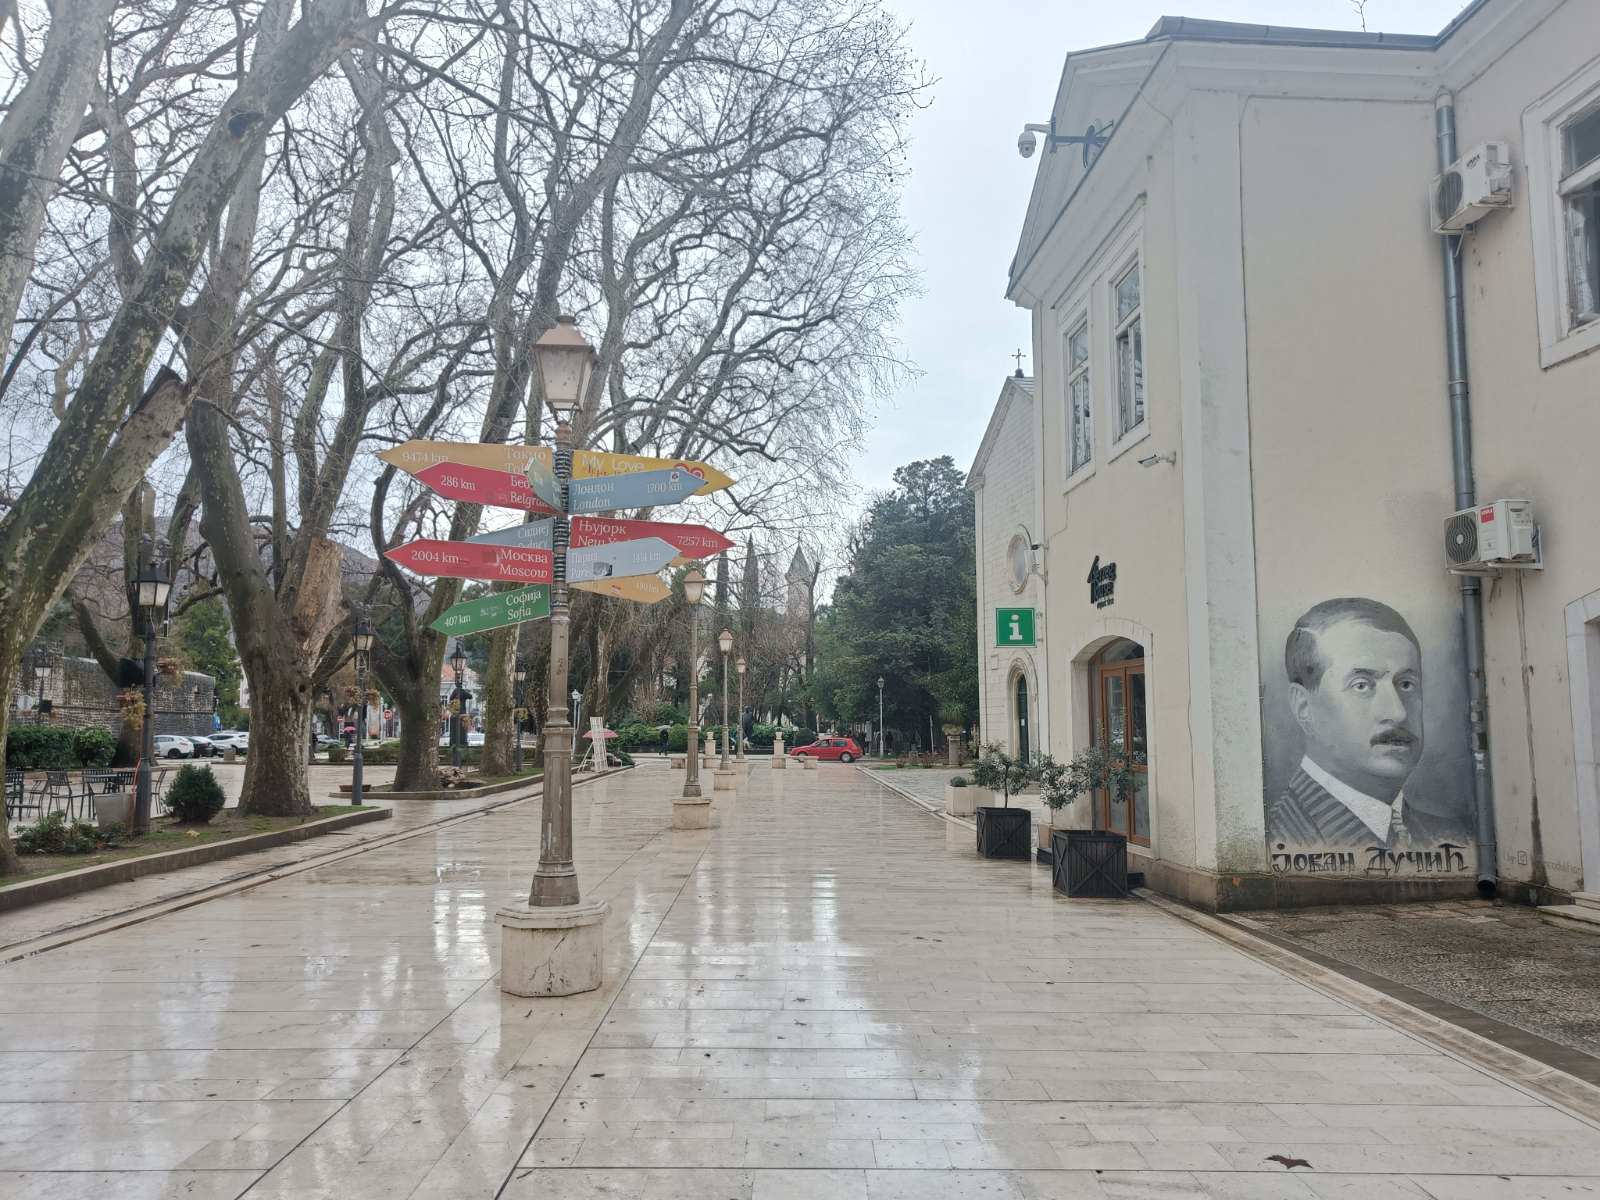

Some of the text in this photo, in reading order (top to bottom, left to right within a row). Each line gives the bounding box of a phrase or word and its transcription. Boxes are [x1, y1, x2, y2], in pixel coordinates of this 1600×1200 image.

[440, 475, 476, 491] 286 km
[574, 481, 615, 496] Лондон
[573, 496, 611, 511] London
[578, 520, 627, 535] Њујорк
[677, 535, 718, 548] 7257 km
[411, 550, 459, 564] 2004 km
[500, 549, 548, 563] Москва
[500, 564, 548, 577] Moscow
[505, 590, 542, 606] Софија
[444, 614, 471, 627] 407 km
[507, 606, 532, 621] Sofia
